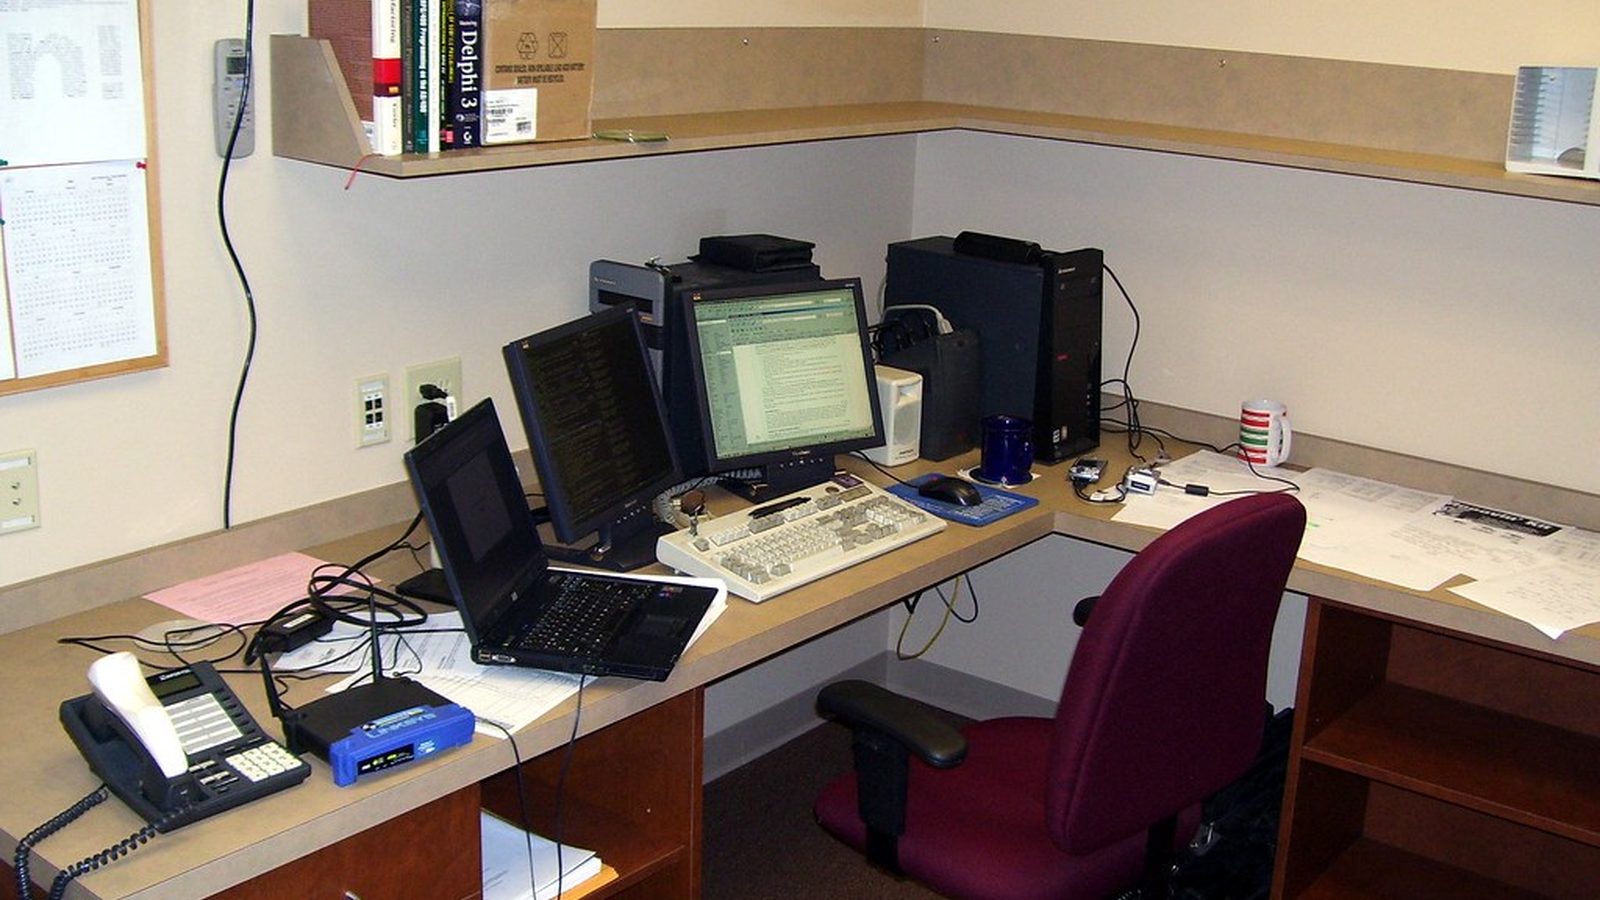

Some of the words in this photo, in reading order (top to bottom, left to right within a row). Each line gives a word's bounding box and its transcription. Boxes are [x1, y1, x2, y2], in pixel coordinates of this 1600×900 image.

[418, 27, 427, 69] Programming
[457, 30, 479, 92] Delphi
[461, 97, 478, 109] 3
